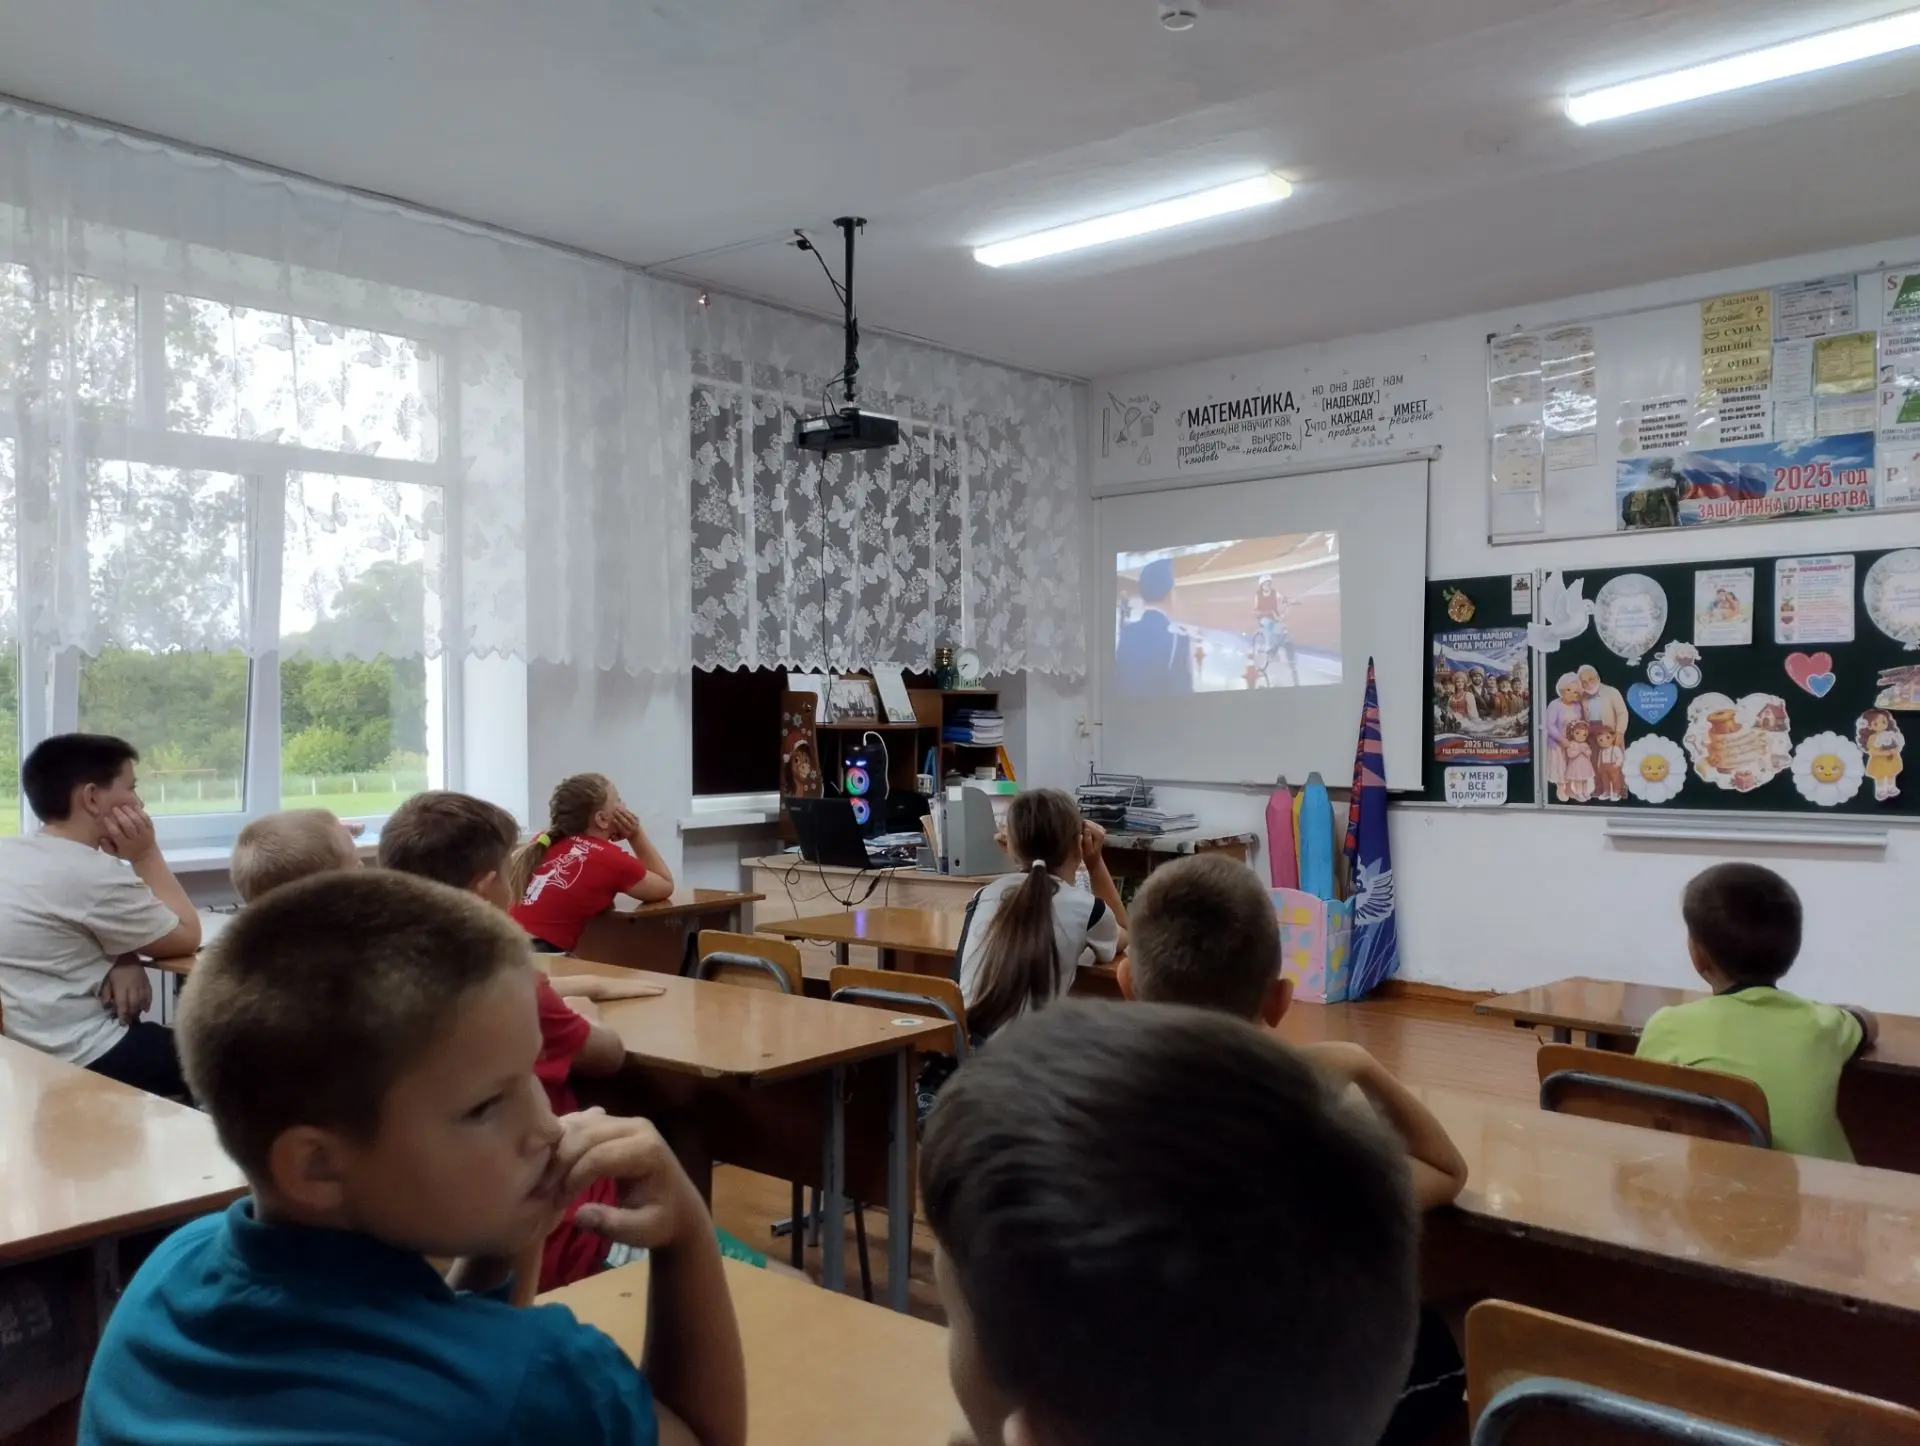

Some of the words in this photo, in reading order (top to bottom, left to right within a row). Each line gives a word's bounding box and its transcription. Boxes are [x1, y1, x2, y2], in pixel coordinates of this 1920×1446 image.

[1312, 384, 1324, 396] но
[1329, 381, 1348, 394] она
[1382, 374, 1404, 387] нам
[1187, 390, 1301, 429] МАТЕМАТИКА,
[1331, 408, 1373, 427] КАЖДАЯ
[1393, 399, 1428, 417] ИМЕЕТ
[1241, 417, 1273, 434] научит
[1274, 416, 1292, 427] как
[1327, 423, 1377, 440] проблема
[1388, 411, 1434, 431] решение
[1251, 430, 1293, 445] вычесть
[1774, 463, 1832, 492] 2025
[1840, 468, 1868, 486] ГОД
[1698, 499, 1783, 520] ЗАЩИТНИКА
[1787, 490, 1868, 512] ОТЕЧЕСТВА
[1453, 641, 1472, 650] СИЛА
[1474, 640, 1507, 649] РОССИИ!
[1482, 631, 1513, 640] НАРОДОВ
[1460, 772, 1467, 780] У
[1469, 772, 1495, 780] МЕНЯ
[1452, 791, 1504, 799] ПОЛУЧИТСЯ!
